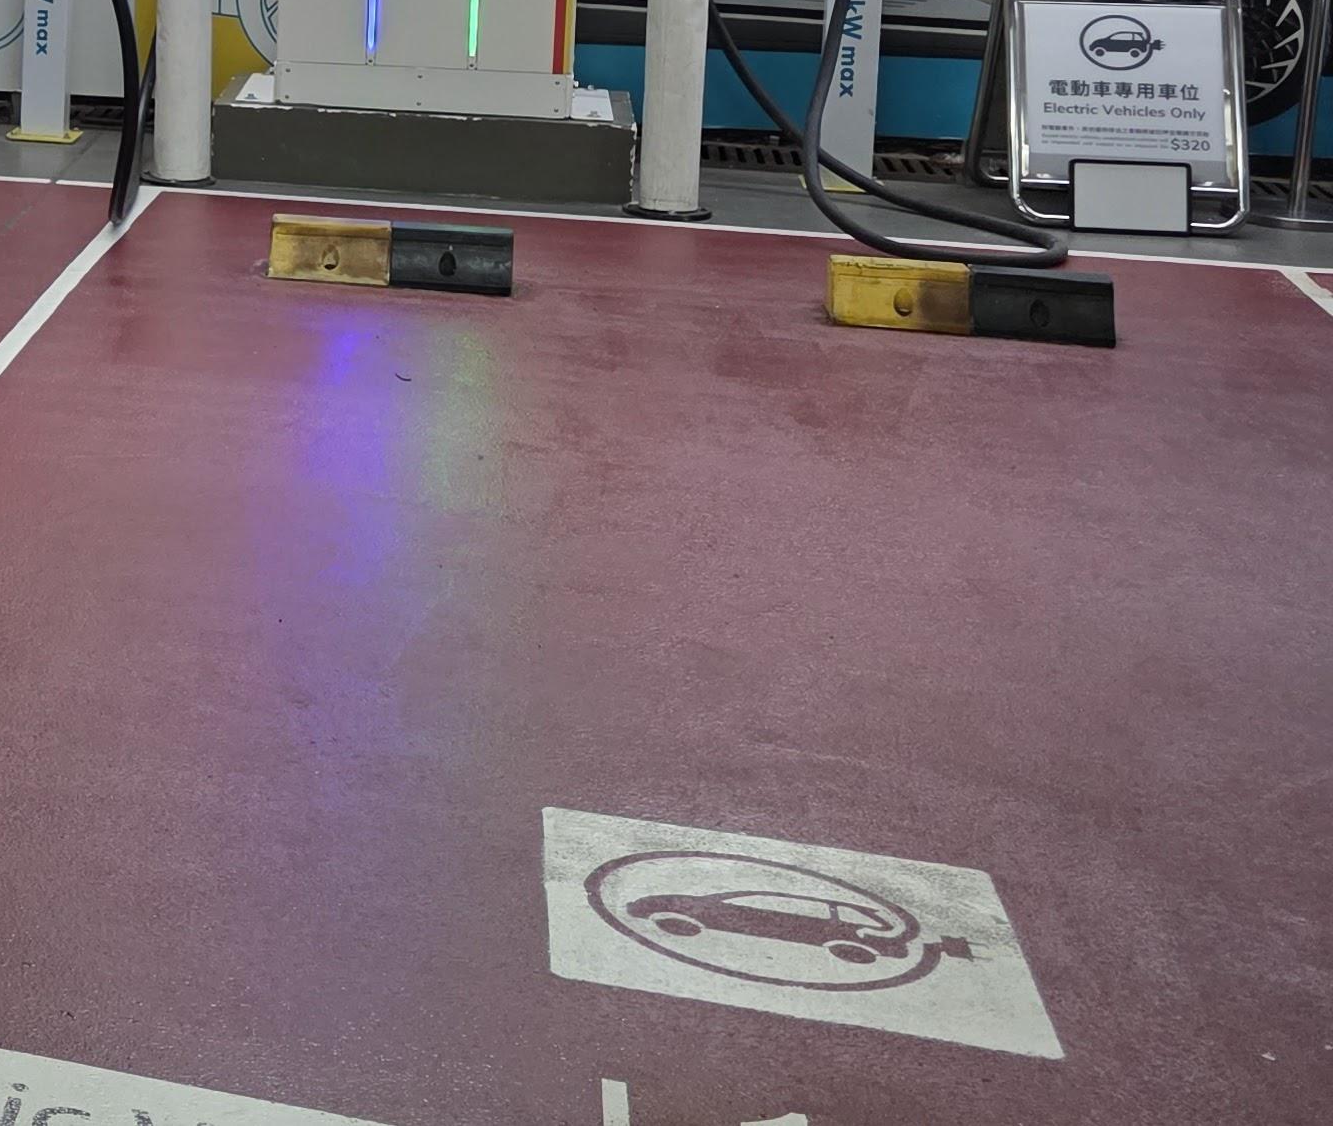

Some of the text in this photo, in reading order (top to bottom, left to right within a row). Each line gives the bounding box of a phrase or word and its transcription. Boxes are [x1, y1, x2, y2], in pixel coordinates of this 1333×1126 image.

[35, 9, 50, 56] max
[838, 45, 856, 98] max
[1048, 79, 1201, 102] 電動車專用車位
[1043, 101, 1206, 122] Electric Vehicles Only
[1170, 137, 1211, 152] $320
